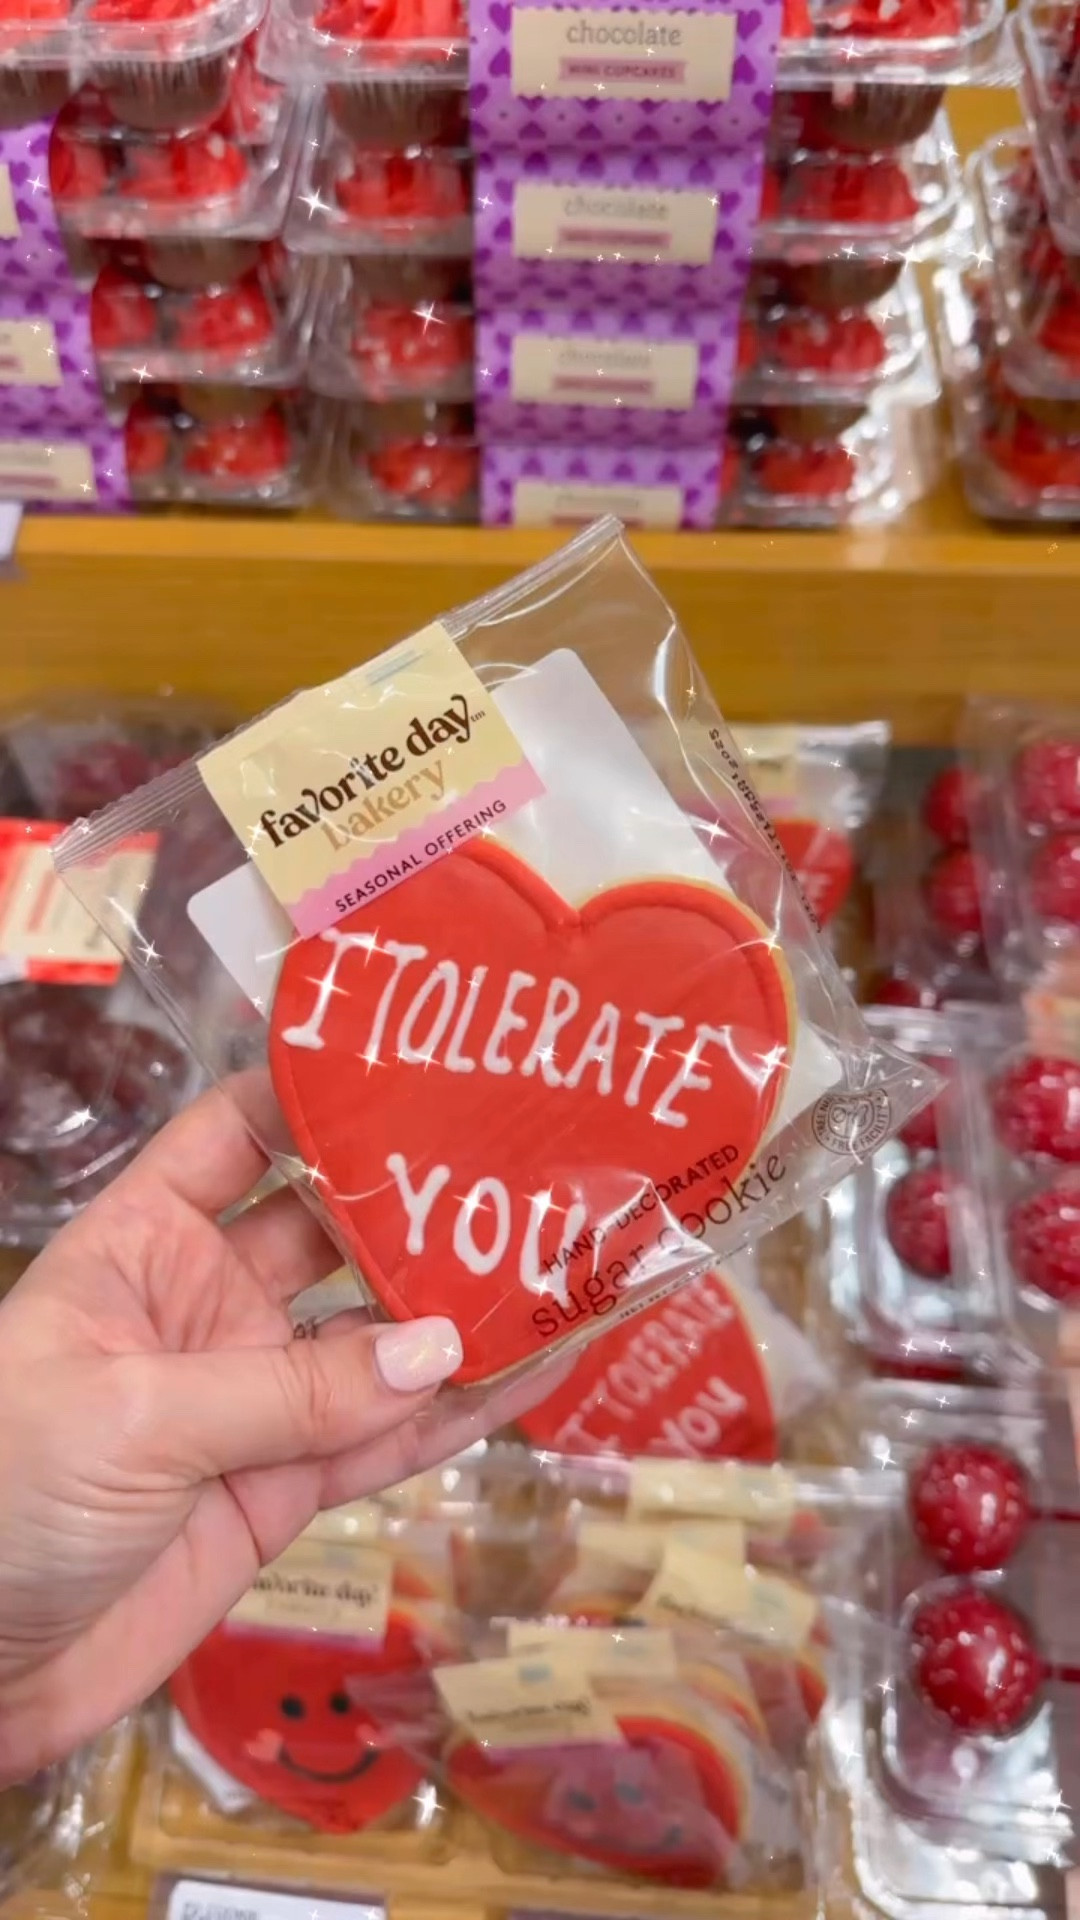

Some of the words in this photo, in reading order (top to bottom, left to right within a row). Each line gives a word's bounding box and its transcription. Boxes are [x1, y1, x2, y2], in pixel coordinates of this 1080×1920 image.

[566, 20, 683, 47] chocolate
[602, 64, 677, 79] CUPCAKES
[259, 744, 406, 848] favorite
[405, 694, 472, 757] day
[320, 759, 446, 852] bakery
[334, 853, 423, 913] SEASONAL
[424, 799, 508, 857] OFFERING
[281, 928, 376, 1050] I
[384, 940, 731, 1128] TOLERATE
[386, 1153, 587, 1309] YOU
[530, 1244, 646, 1338] sugar
[657, 1154, 787, 1254] cookie
